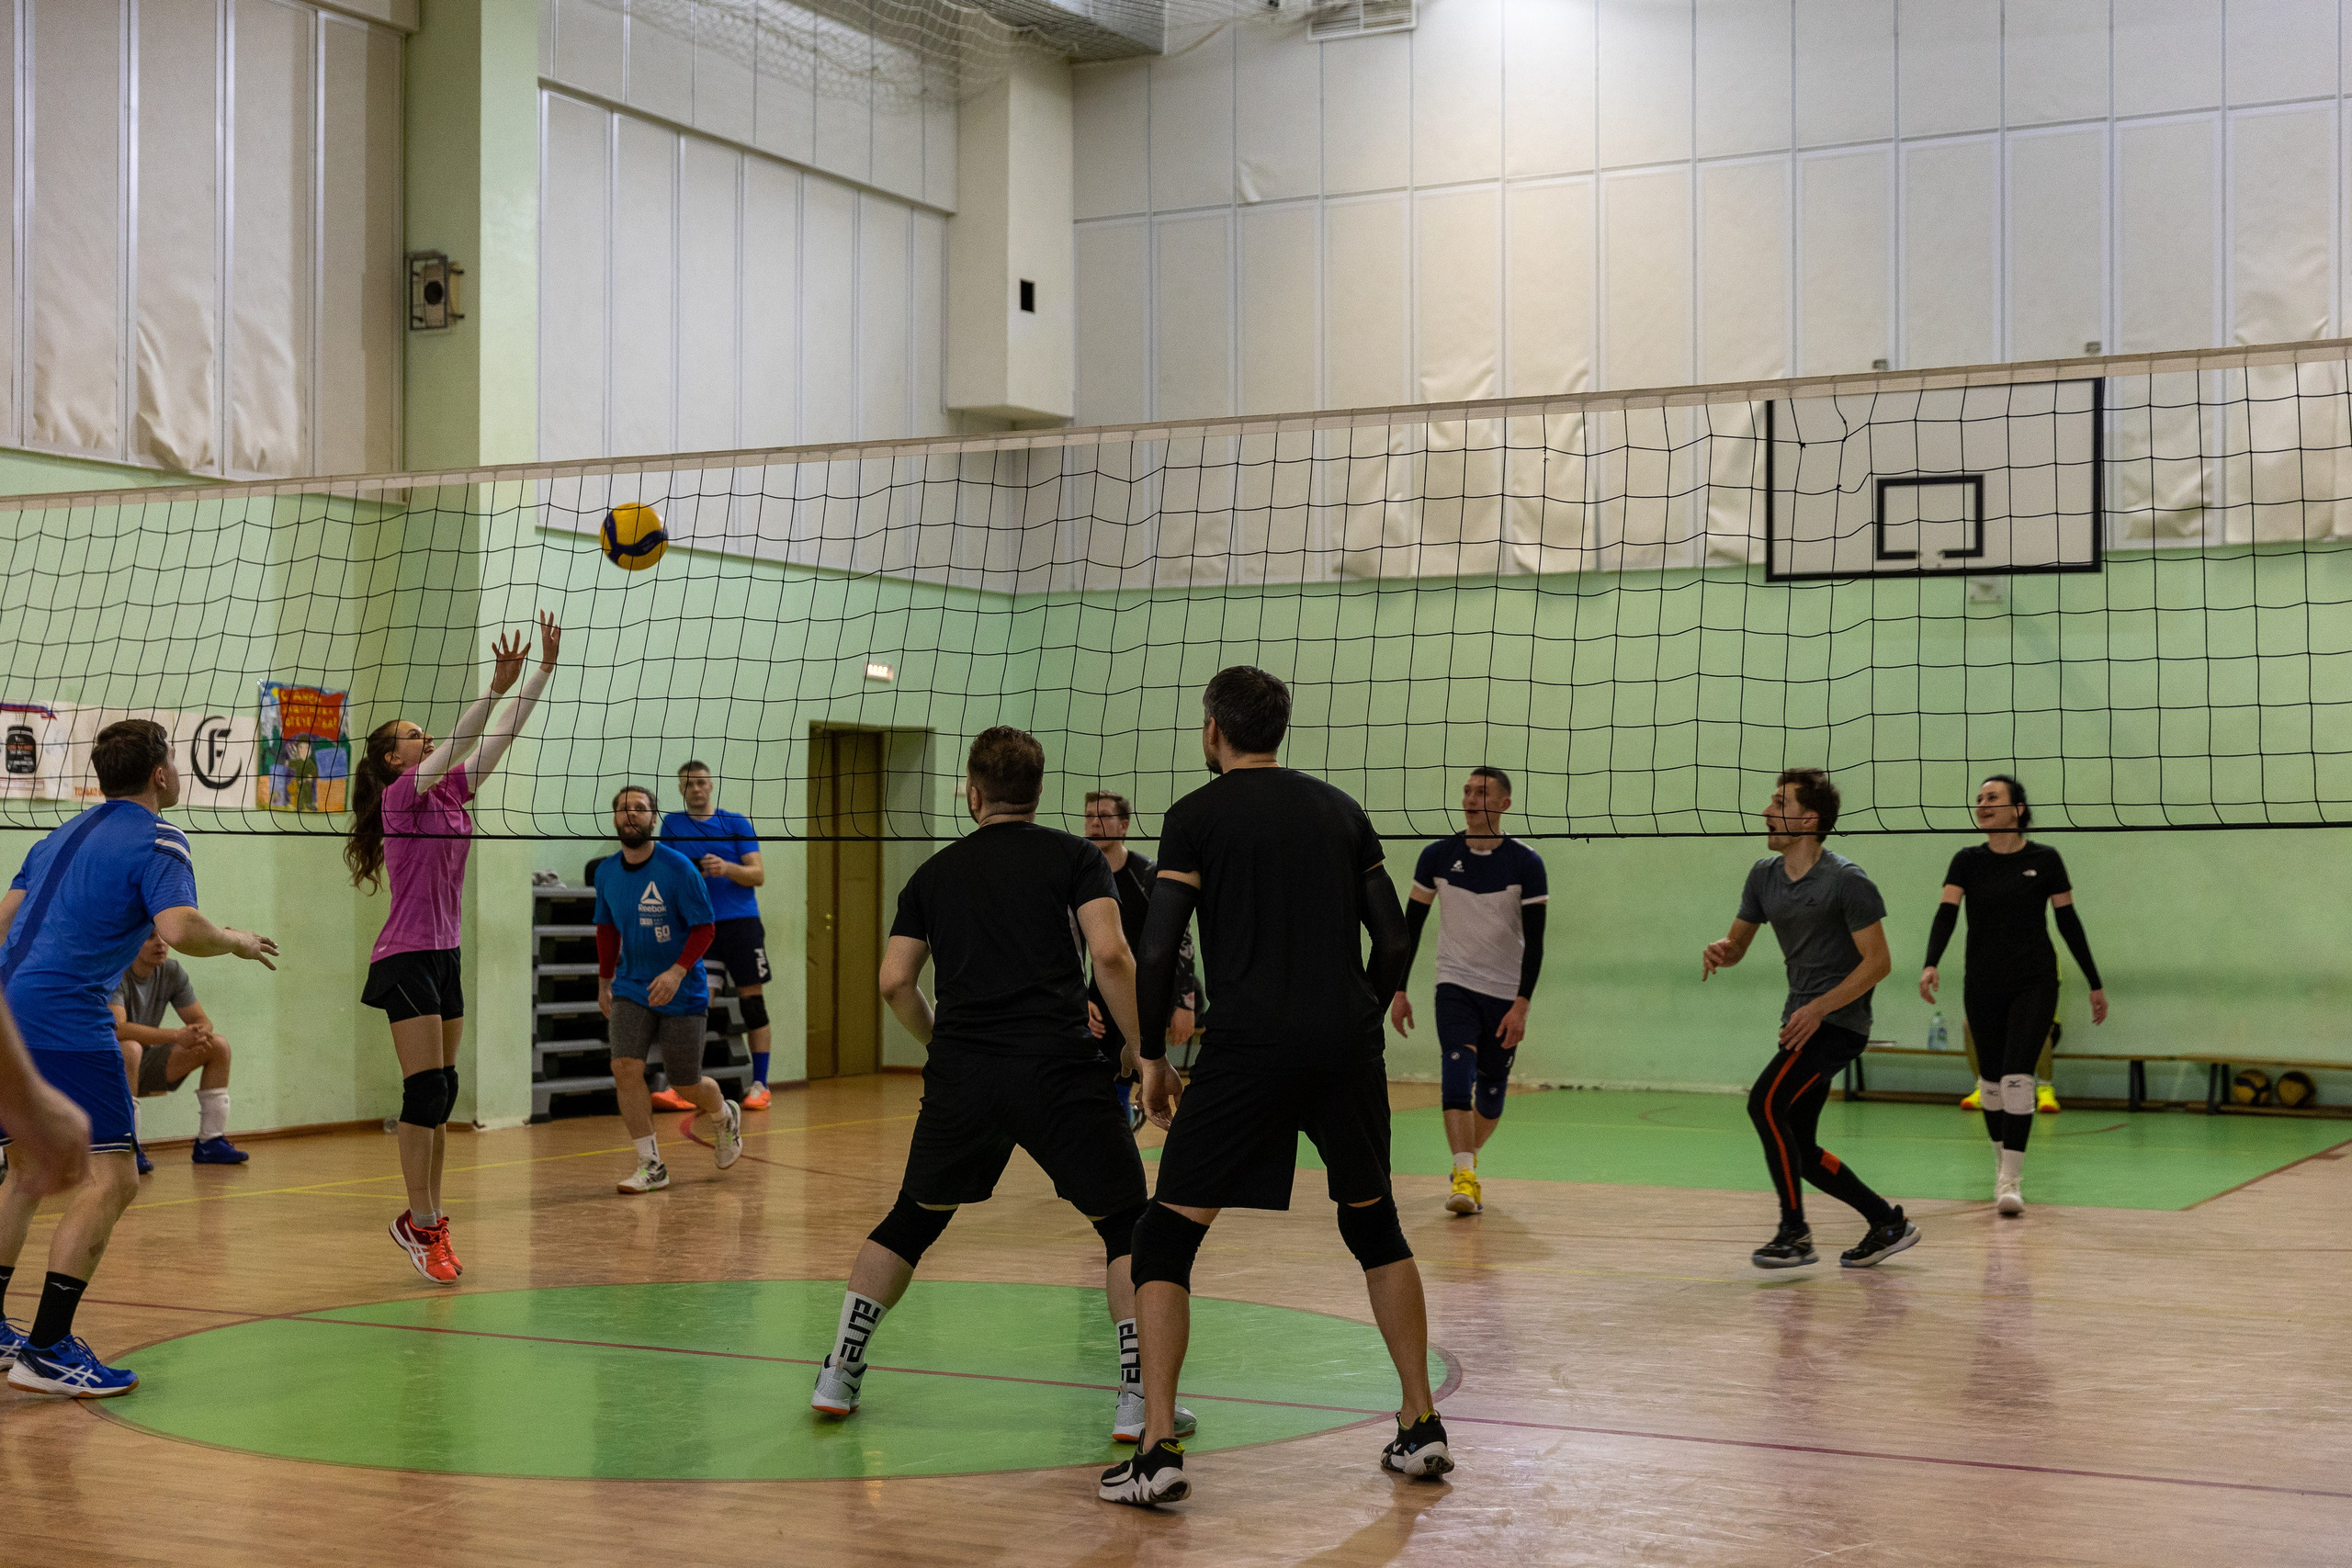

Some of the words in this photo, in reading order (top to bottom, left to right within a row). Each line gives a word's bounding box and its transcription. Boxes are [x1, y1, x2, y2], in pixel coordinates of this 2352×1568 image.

[638, 903, 667, 913] Reebok
[753, 947, 768, 978] FILA
[840, 1297, 882, 1362] ELITE
